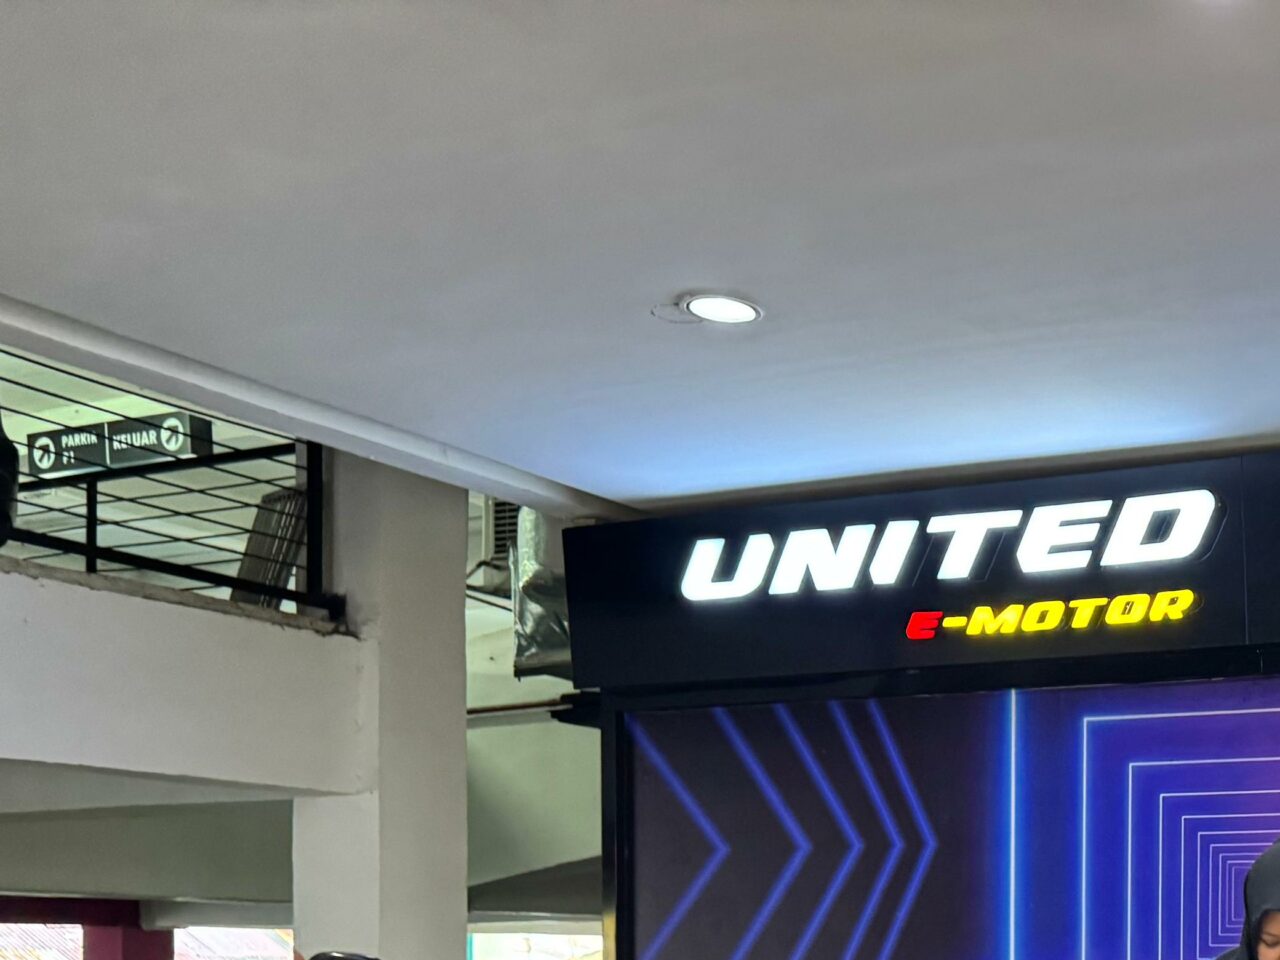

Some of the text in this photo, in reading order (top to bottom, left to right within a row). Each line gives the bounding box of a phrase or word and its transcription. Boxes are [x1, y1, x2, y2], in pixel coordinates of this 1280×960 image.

[113, 430, 157, 450] KELUAR
[681, 489, 1216, 601] UNITED
[905, 588, 1195, 640] E-MOTOR
